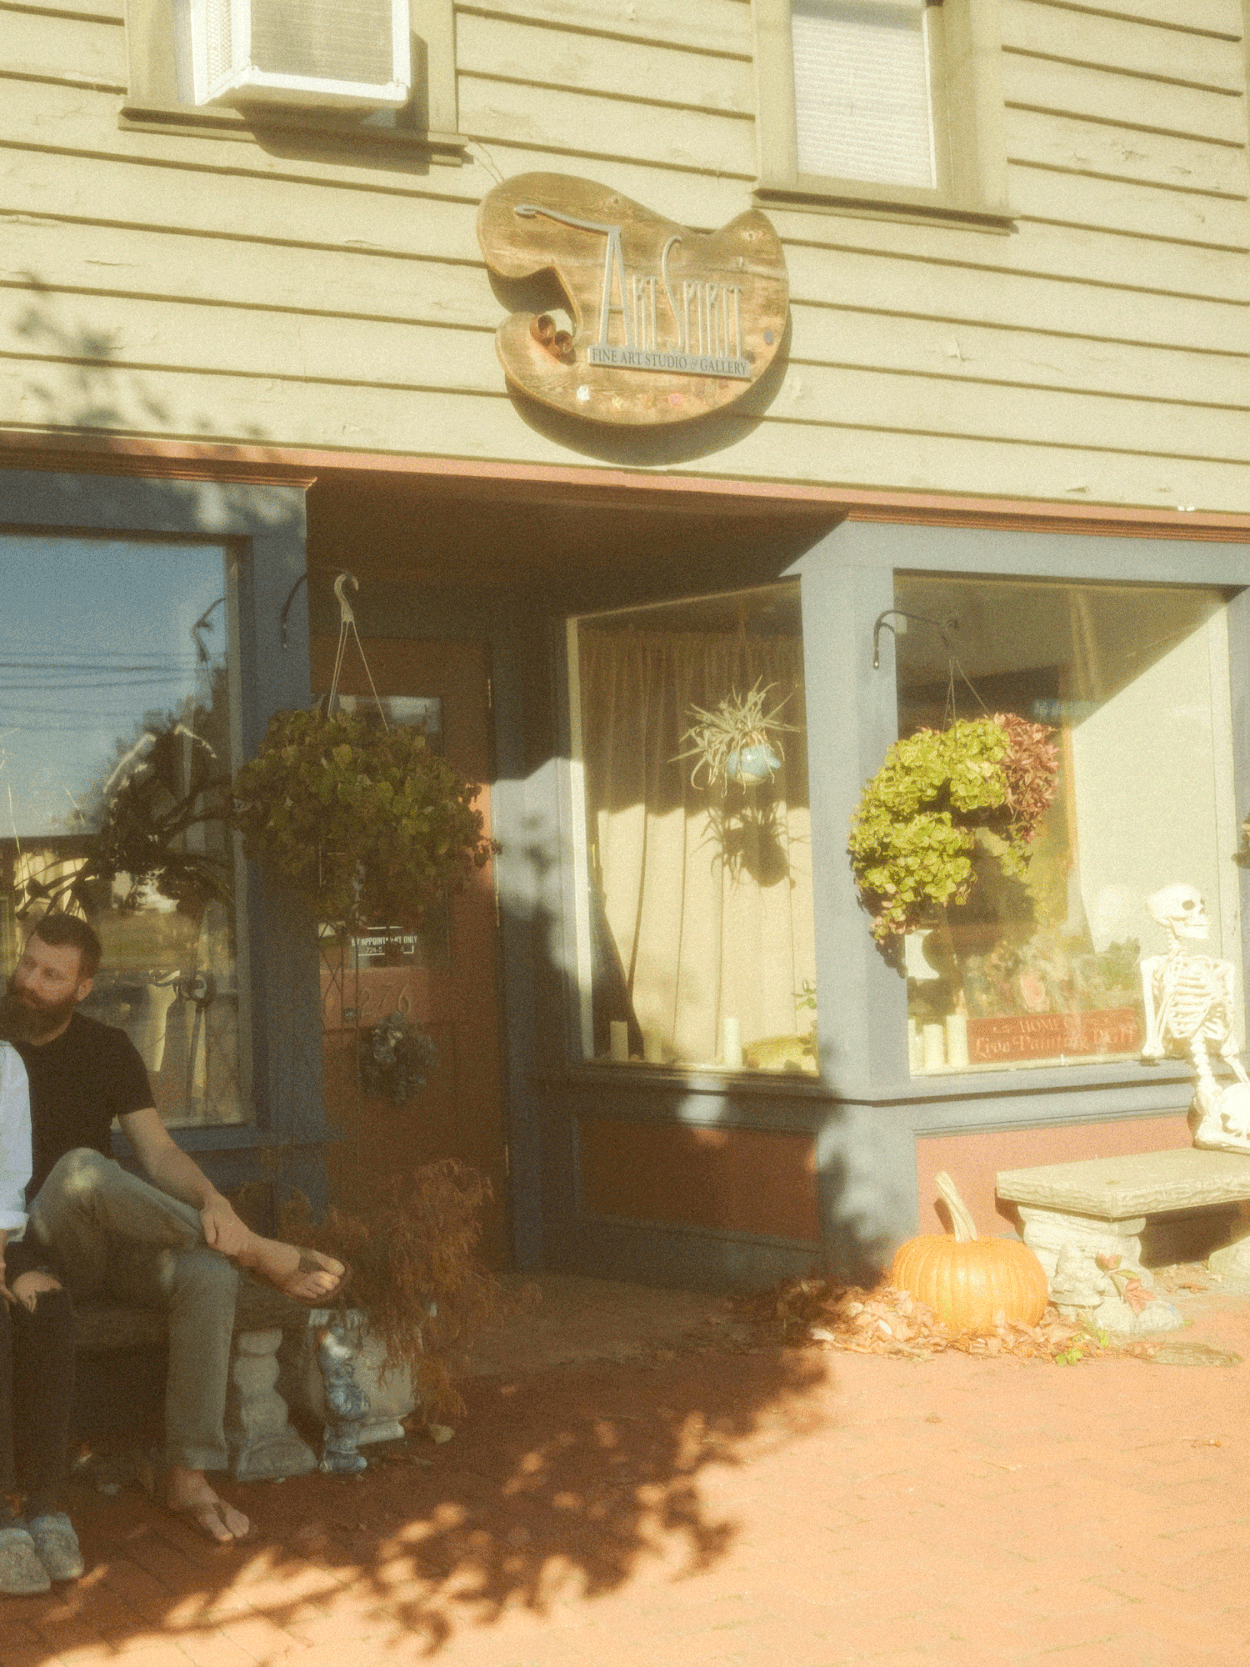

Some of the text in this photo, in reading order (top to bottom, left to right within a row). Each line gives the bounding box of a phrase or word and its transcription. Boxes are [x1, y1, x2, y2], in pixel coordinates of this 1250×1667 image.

[592, 347, 617, 363] FINE
[620, 351, 643, 366] ART
[645, 353, 688, 370] STUDIO
[700, 357, 747, 376] GALLERY
[403, 935, 418, 945] ONLY
